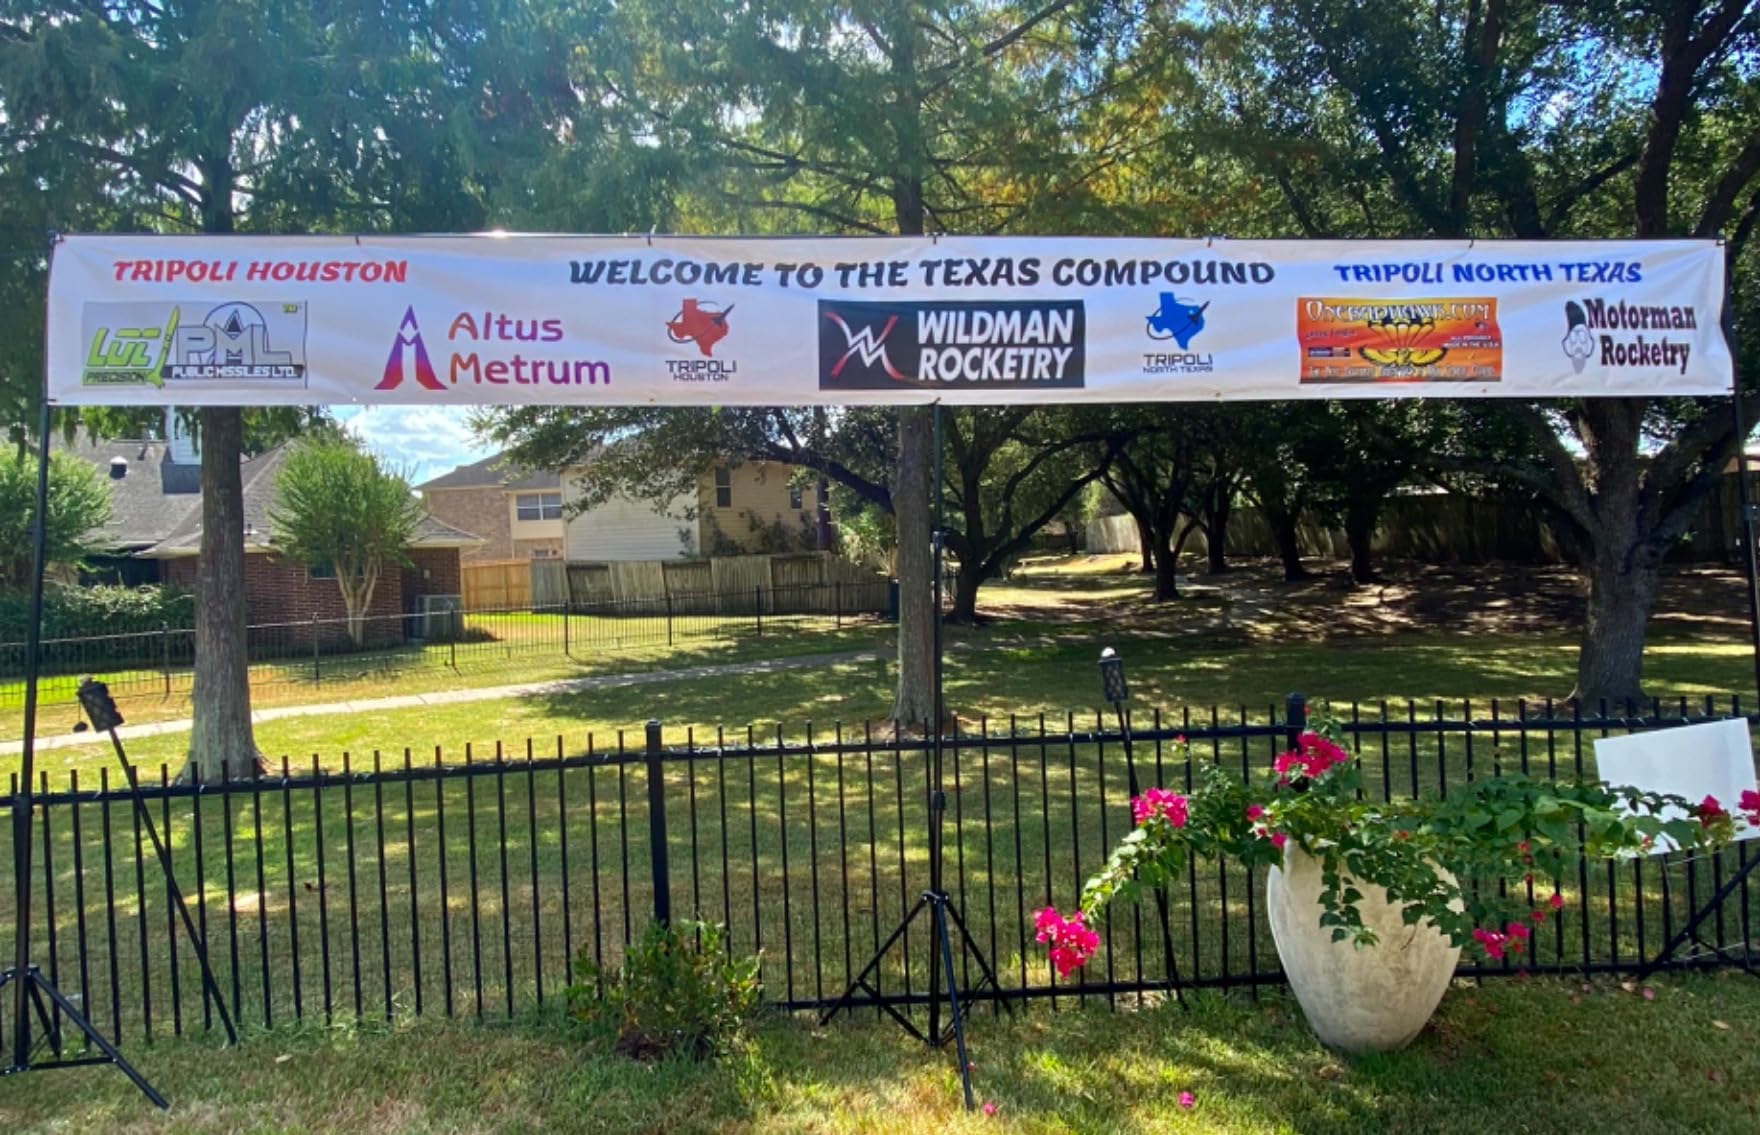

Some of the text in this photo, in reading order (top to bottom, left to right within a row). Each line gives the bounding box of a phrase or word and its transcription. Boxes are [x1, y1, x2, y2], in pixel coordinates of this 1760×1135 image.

[113, 260, 407, 282] TRIPOLI HOUSTON
[569, 258, 1275, 288] WELCOME TO THE TEXAS COMPOUND
[1334, 262, 1642, 283] TRIPOLI NORTH TEXAS
[448, 311, 563, 341] Altus
[917, 309, 1075, 345] WILDMAN
[1583, 298, 1697, 329] Motorman
[176, 323, 293, 365] PML
[1600, 335, 1691, 375] Rocketry
[172, 366, 216, 378] PUBLIC
[217, 366, 270, 378] MISSILES
[450, 352, 611, 385] Metrum
[665, 360, 737, 373] TRIPOLI
[917, 347, 1074, 381] ROCKETRY
[1143, 353, 1213, 366] TRIPOLI
[673, 373, 729, 381] HOUSTON
